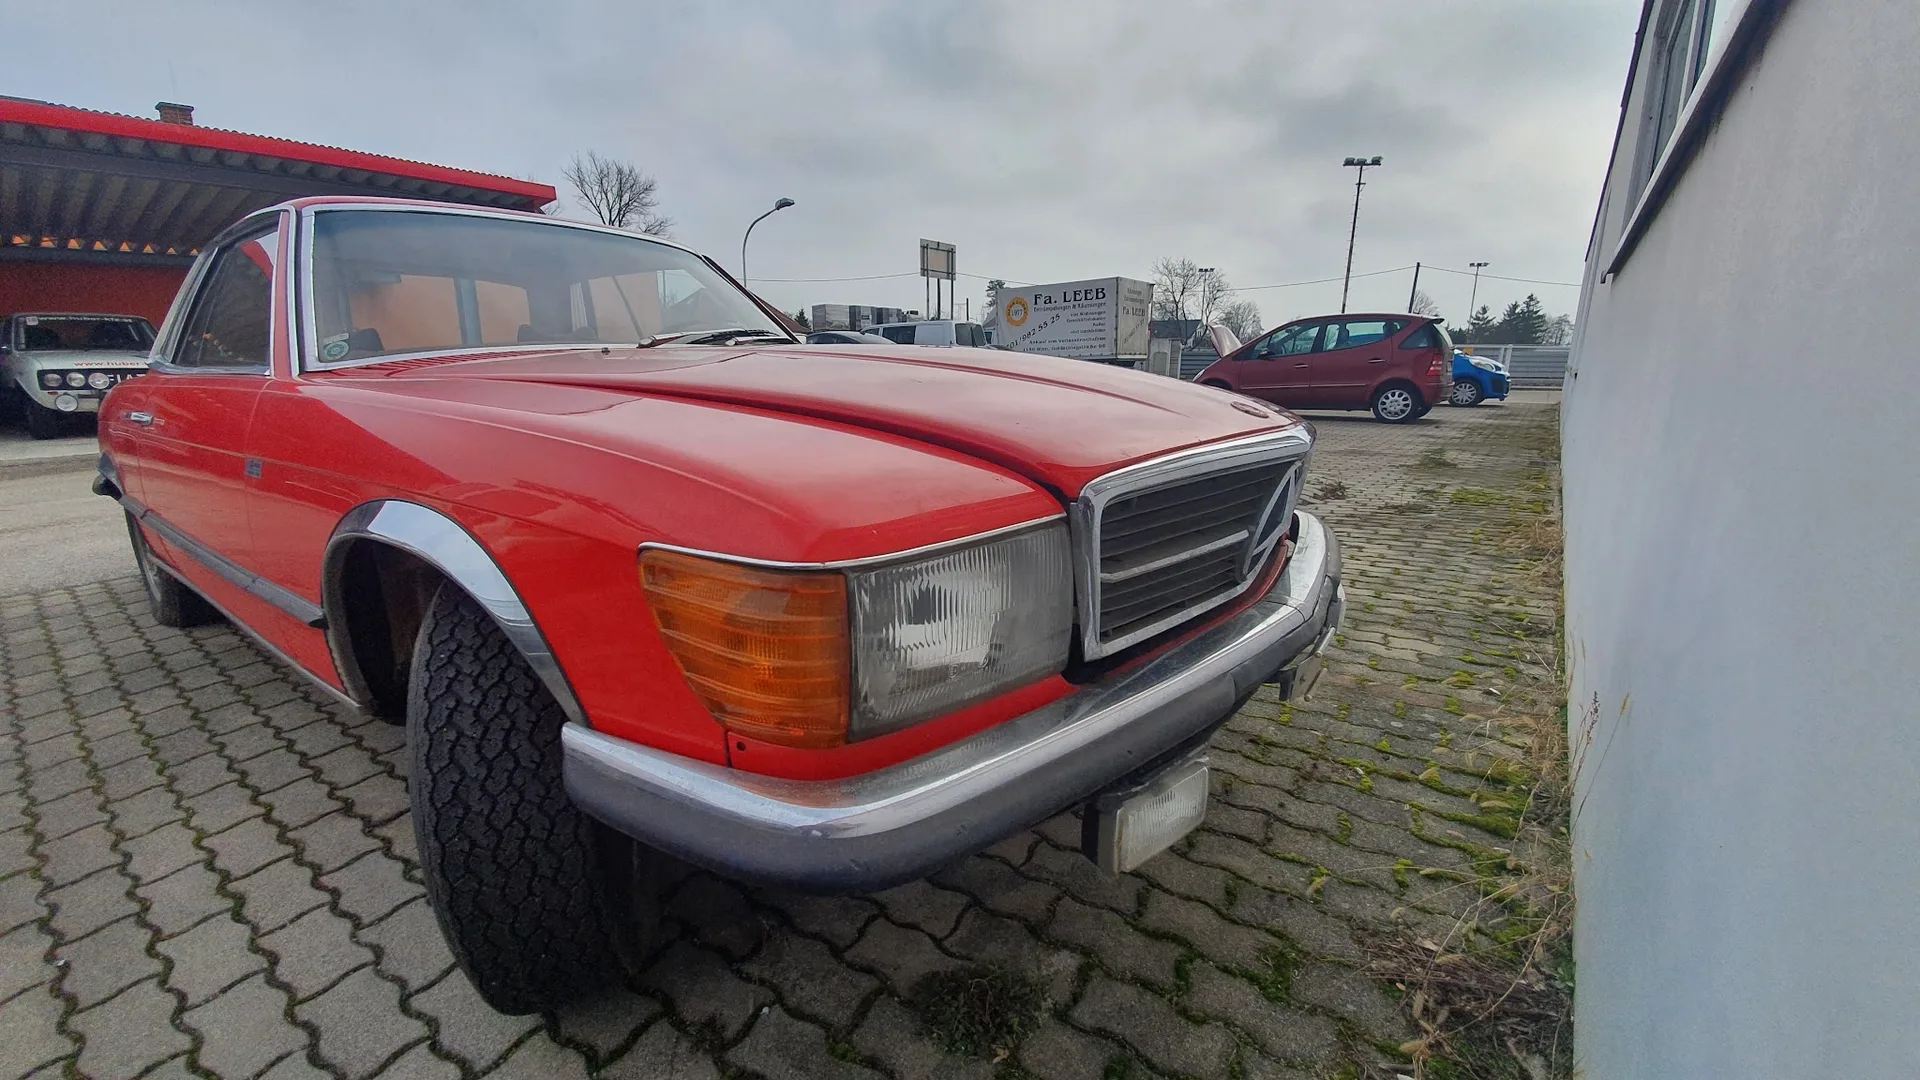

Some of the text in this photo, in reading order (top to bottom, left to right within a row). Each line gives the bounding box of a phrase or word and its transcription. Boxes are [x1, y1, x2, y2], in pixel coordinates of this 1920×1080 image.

[1033, 293, 1057, 306] Fa.
[1062, 287, 1107, 303] LEEB
[1011, 309, 1023, 317] 1977
[1038, 320, 1048, 331] 55
[1050, 313, 1060, 324] 25
